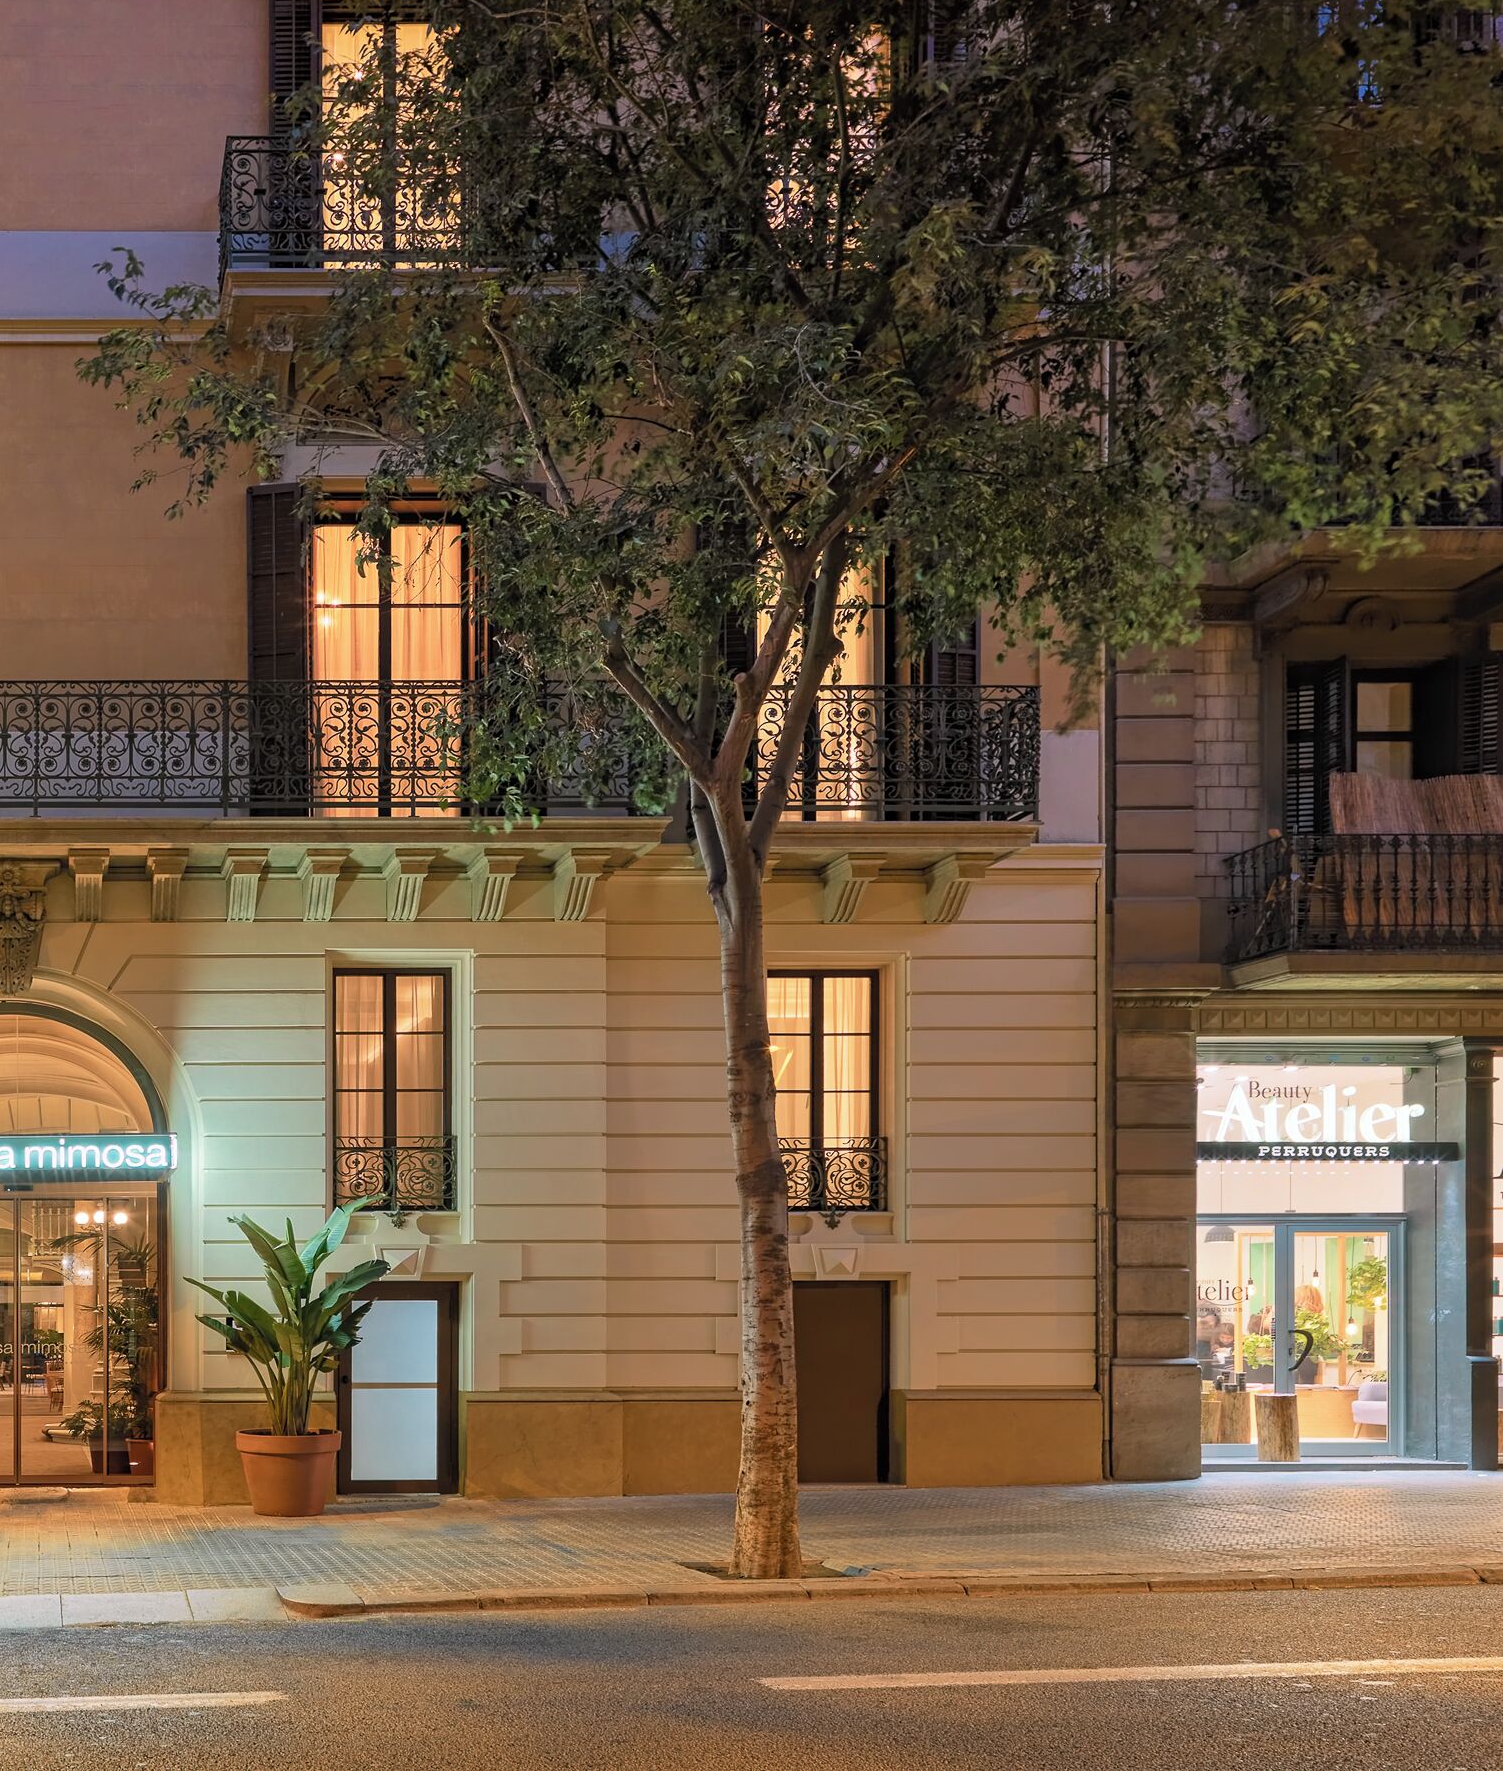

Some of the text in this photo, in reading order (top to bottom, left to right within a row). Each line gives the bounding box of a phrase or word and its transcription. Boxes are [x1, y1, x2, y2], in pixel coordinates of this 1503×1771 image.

[1248, 1080, 1312, 1103] Beauty
[1201, 1083, 1425, 1142] Atelier
[24, 1138, 169, 1169] mimosa
[1258, 1146, 1390, 1157] PERRUQUERS
[1197, 1279, 1249, 1301] telier
